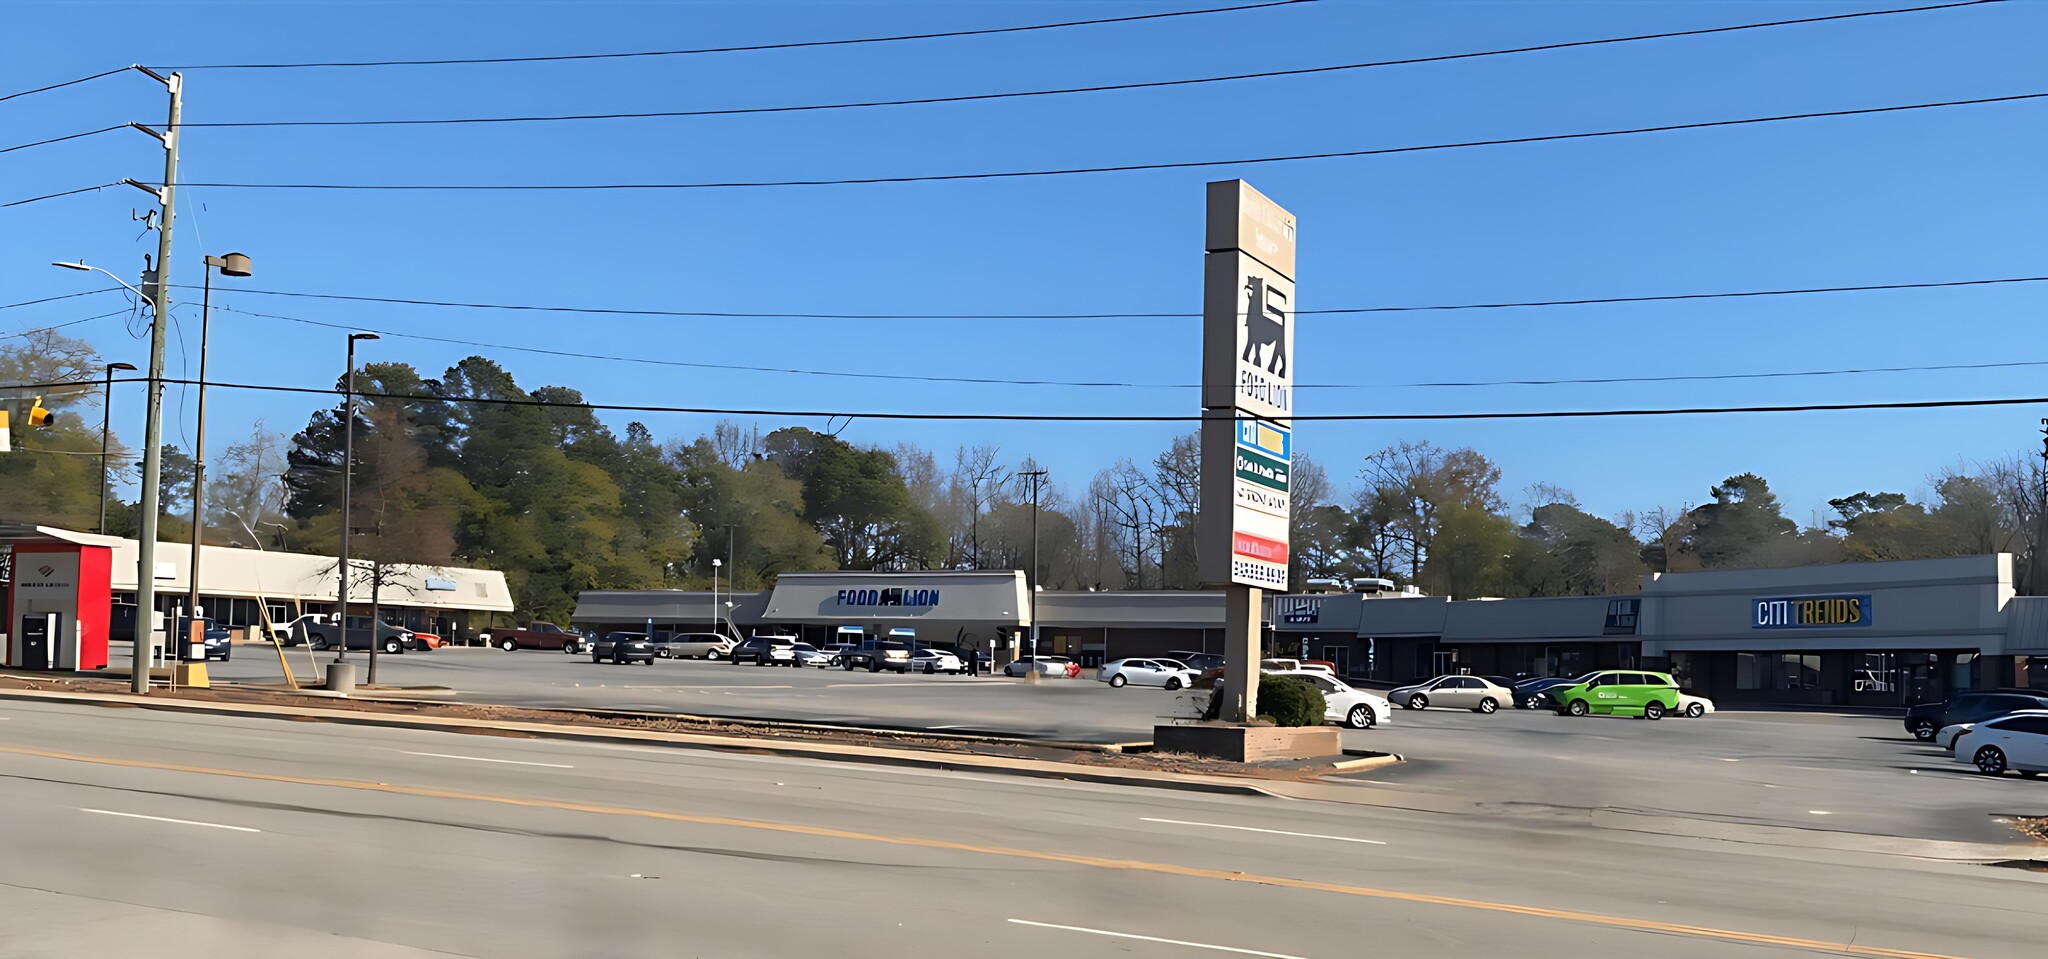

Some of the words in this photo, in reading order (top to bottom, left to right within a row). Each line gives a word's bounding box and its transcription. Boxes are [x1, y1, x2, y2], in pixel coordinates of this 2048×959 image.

[837, 589, 878, 606] FOOD
[903, 589, 939, 606] LION
[1791, 598, 1861, 625] TRENDS
